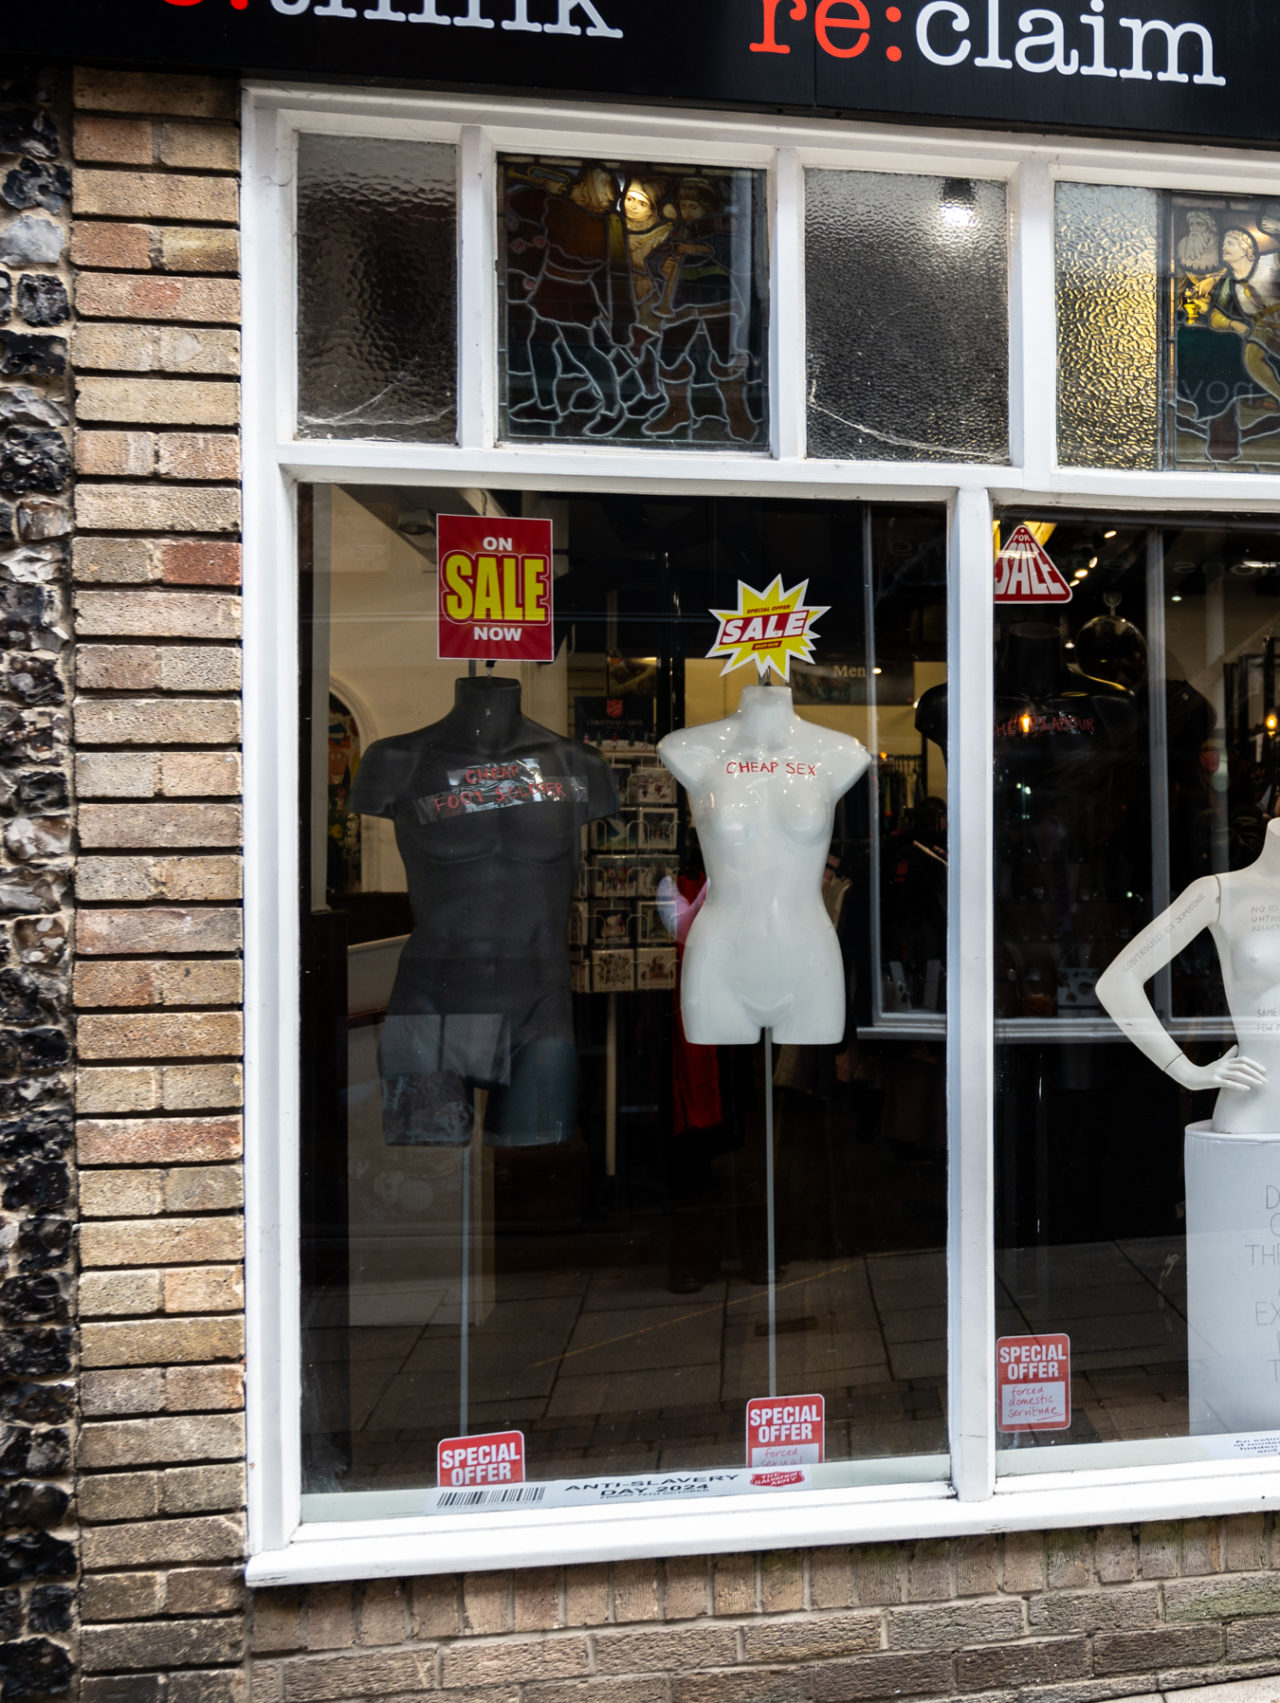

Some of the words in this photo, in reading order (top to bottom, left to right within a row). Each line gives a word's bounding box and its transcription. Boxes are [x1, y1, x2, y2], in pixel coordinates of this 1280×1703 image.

[750, 0, 1227, 86] re:claim
[483, 537, 512, 551] ON
[1013, 534, 1032, 542] FOR
[446, 554, 545, 621] SALE
[474, 627, 522, 641] NOW
[721, 611, 808, 644] SALE
[833, 664, 866, 678] Men
[465, 764, 520, 784] CHEAP
[726, 761, 779, 774] CHEAP
[785, 762, 816, 776] SEX
[434, 790, 484, 812] FOOT
[1251, 905, 1266, 913] NO
[1256, 1008, 1278, 1017] SAME
[1000, 1343, 1067, 1363] SPECIAL
[1007, 1361, 1060, 1380] OFFER
[1008, 1394, 1055, 1407] domestic
[1011, 1385, 1044, 1397] forced
[750, 1405, 821, 1427] SPECIAL
[758, 1422, 813, 1443] OFFER
[441, 1442, 521, 1469] SPECIAL
[451, 1462, 512, 1487] OFFER
[564, 1473, 739, 1492] ANTI-SLAVERY
[600, 1486, 647, 1496] DAY
[655, 1483, 709, 1493] 2024
